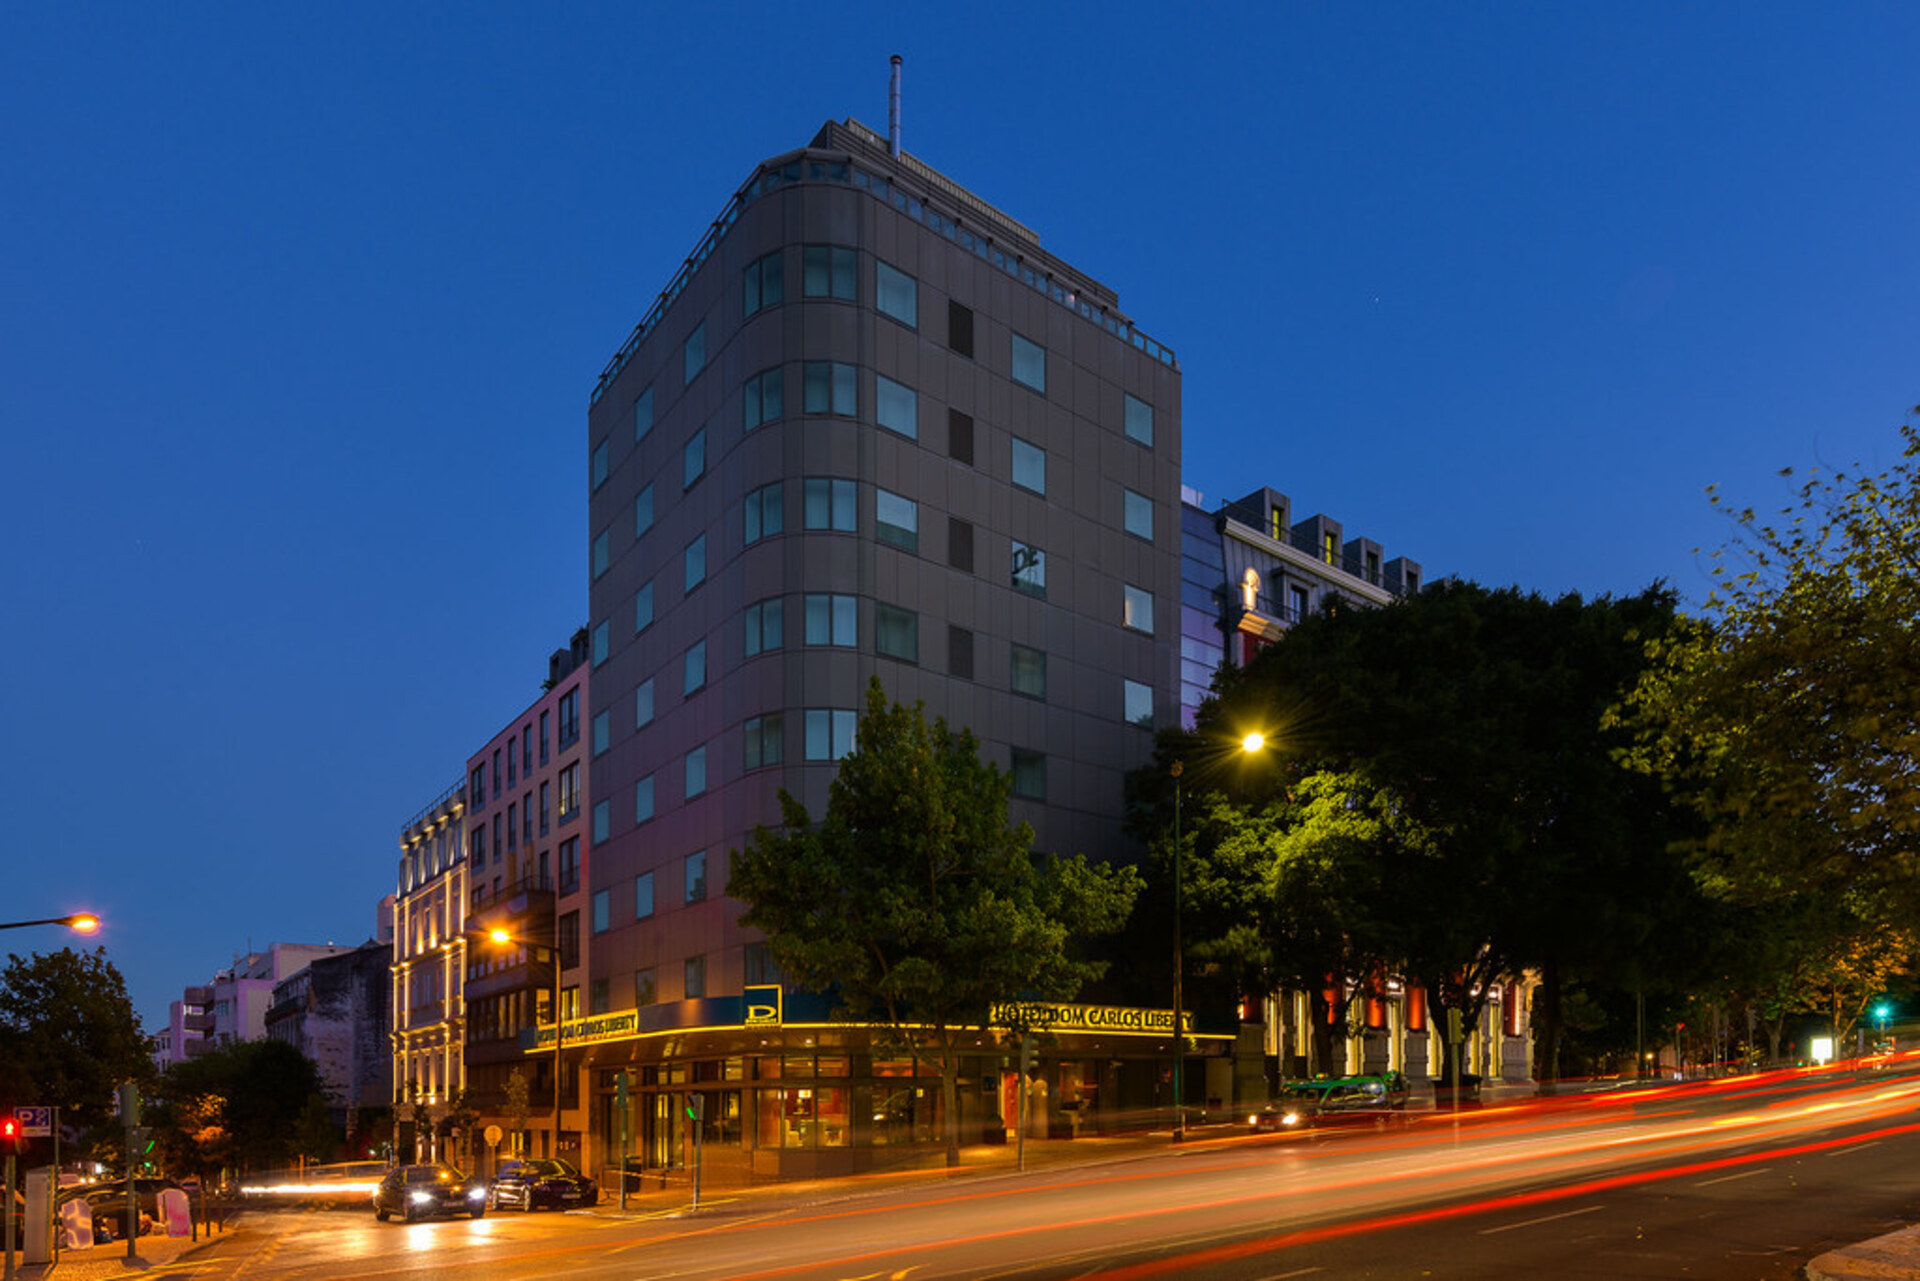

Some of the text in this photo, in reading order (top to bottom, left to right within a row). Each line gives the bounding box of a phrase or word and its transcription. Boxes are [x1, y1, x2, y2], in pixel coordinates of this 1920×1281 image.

[747, 1005, 777, 1019] D
[1049, 1008, 1085, 1025] DOM
[1088, 1009, 1141, 1026] CARLOS
[1144, 1013, 1192, 1029] LIBERY
